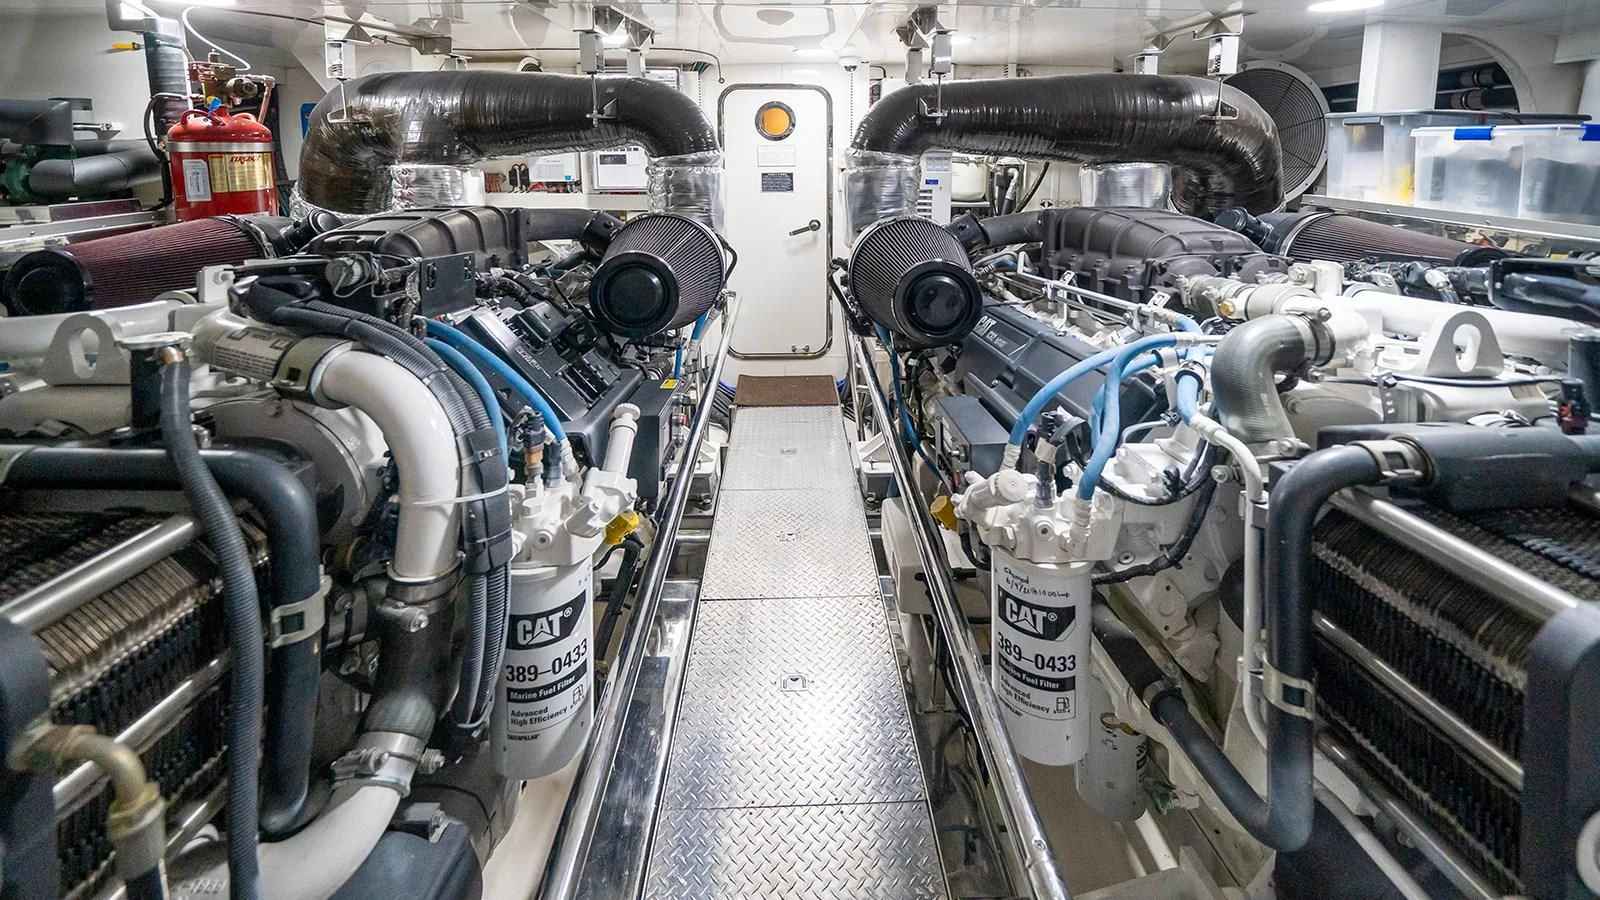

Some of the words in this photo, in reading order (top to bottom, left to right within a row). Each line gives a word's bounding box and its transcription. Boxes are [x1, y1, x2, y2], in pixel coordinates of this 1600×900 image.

[973, 315, 997, 337] CAT
[505, 638, 588, 682] 389-0433
[998, 631, 1077, 673] 389-0433
[509, 690, 538, 701] Marine
[539, 684, 557, 698] Fuel
[557, 675, 576, 691] Filter
[1022, 673, 1039, 687] Fuel
[1040, 680, 1061, 690] Filter
[510, 705, 549, 718] Advanced
[1014, 692, 1051, 714] Efficiency
[510, 717, 529, 727] High
[529, 706, 568, 726] Efficiency
